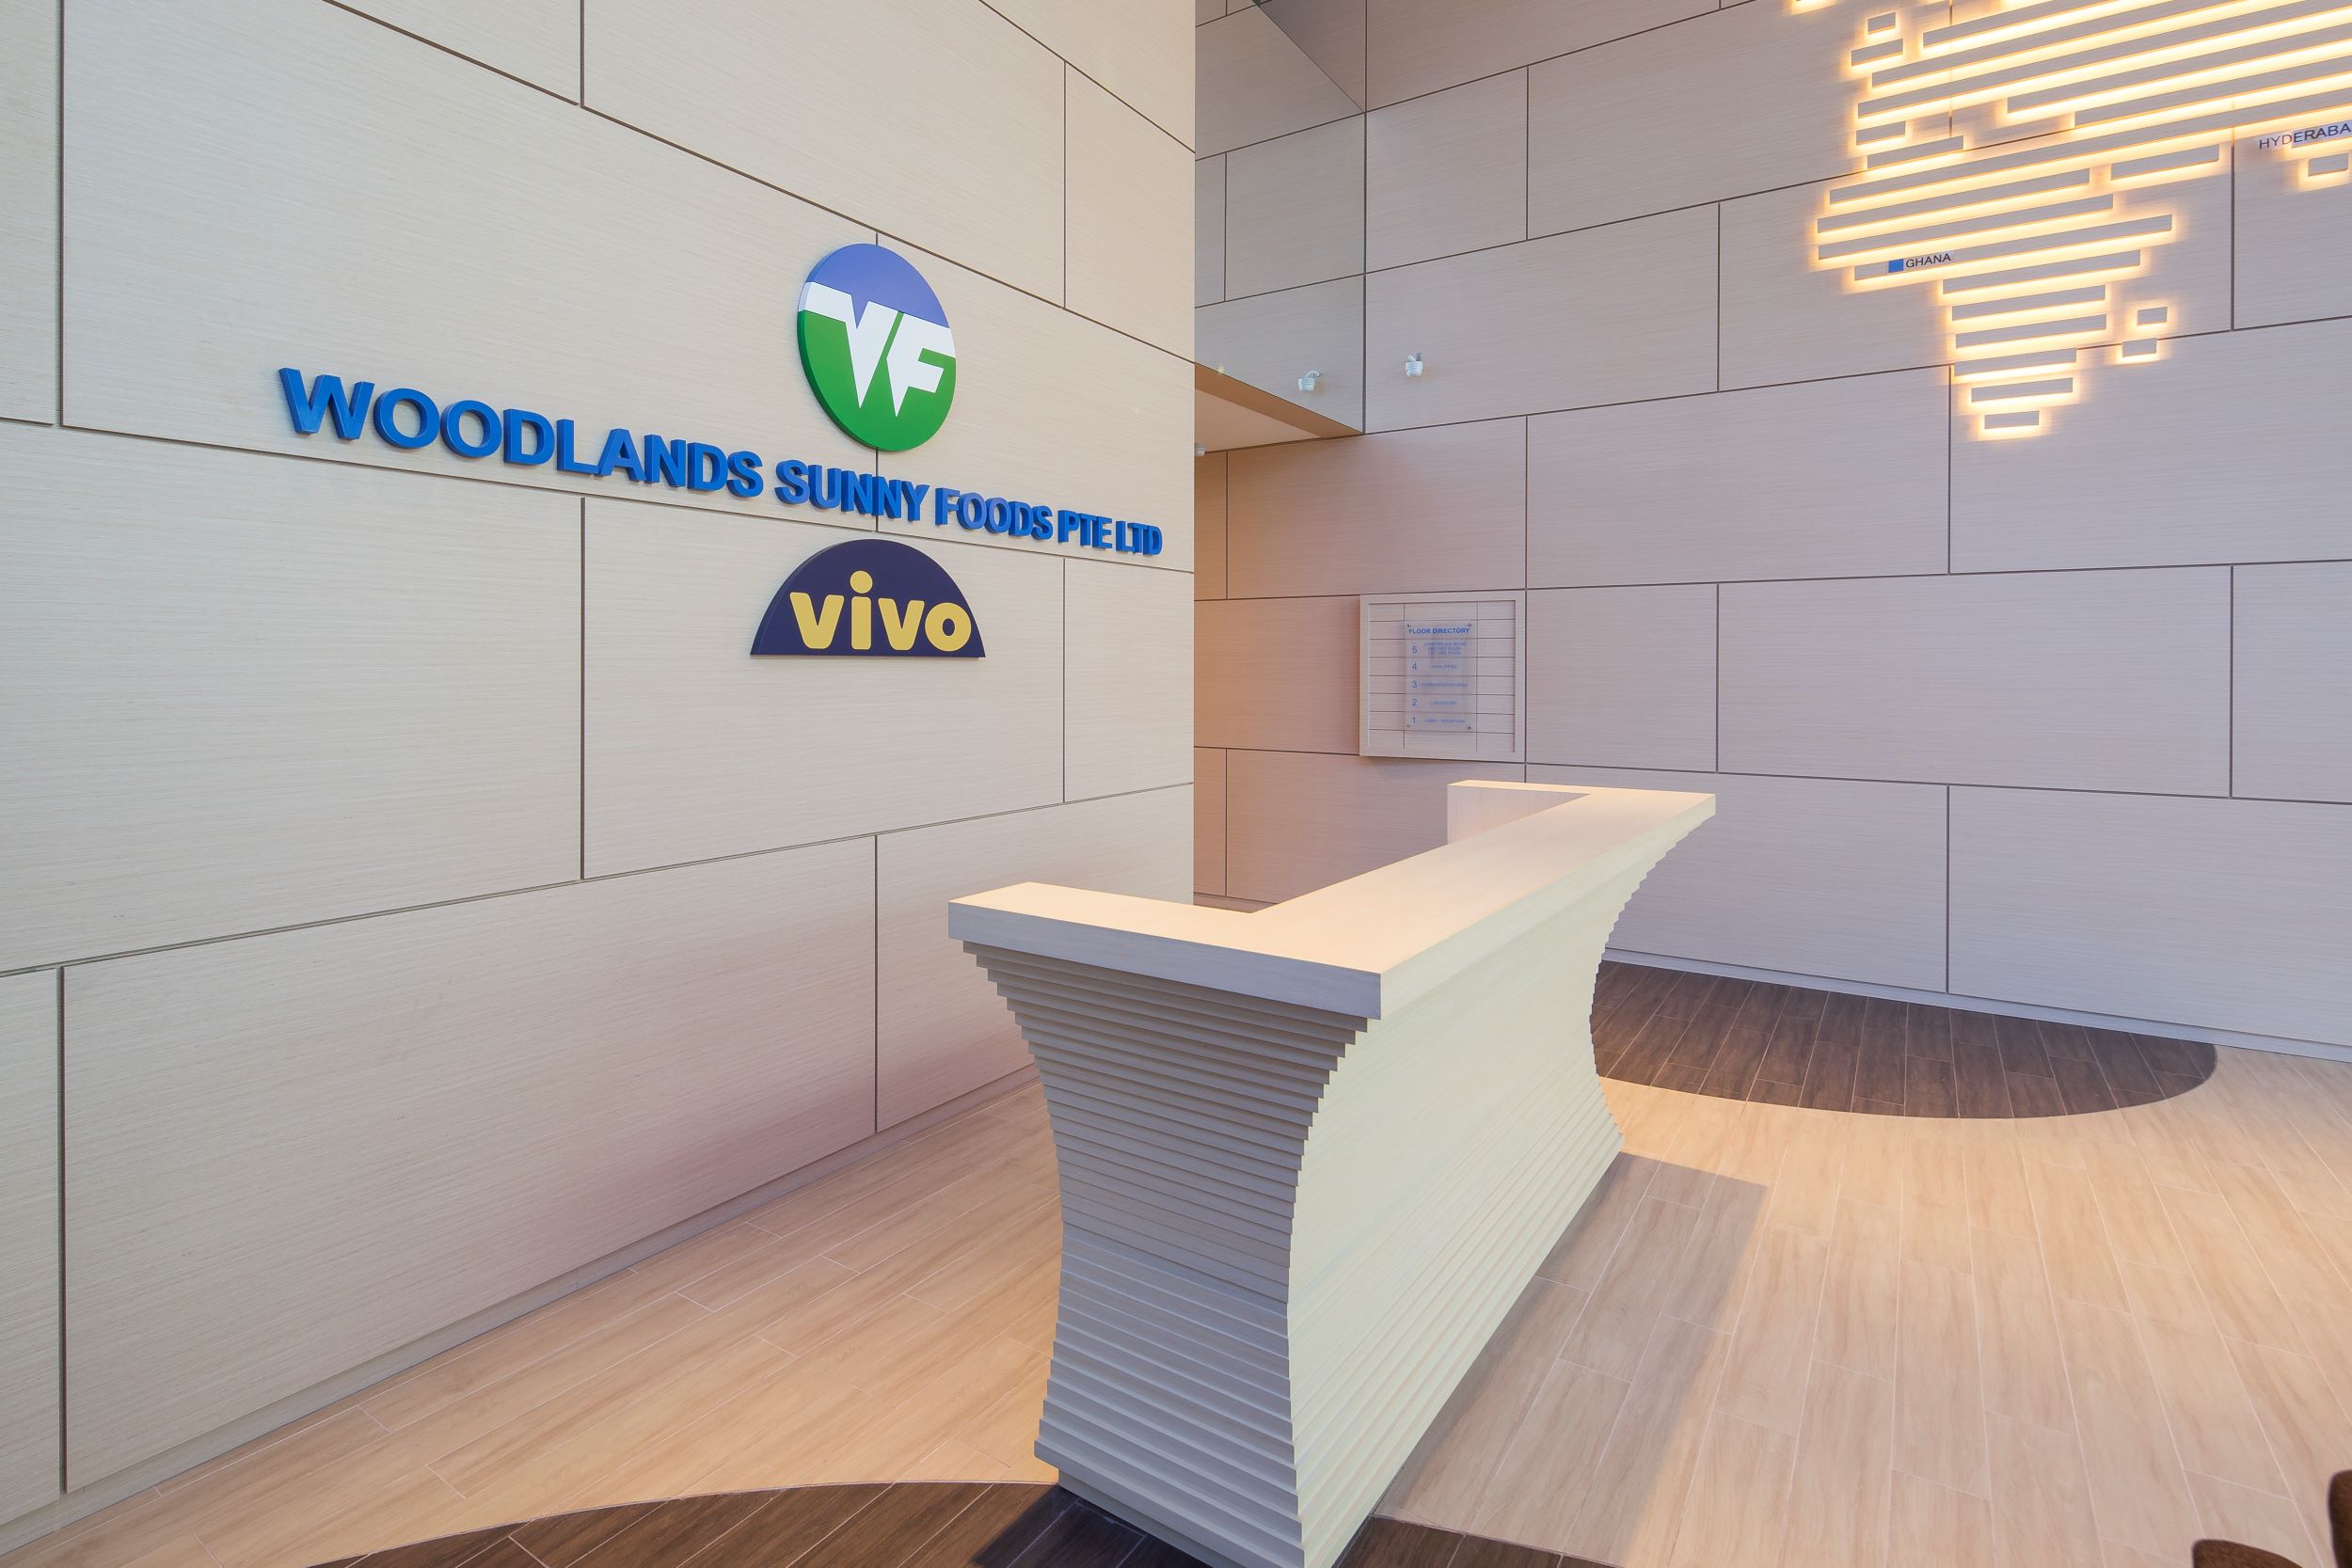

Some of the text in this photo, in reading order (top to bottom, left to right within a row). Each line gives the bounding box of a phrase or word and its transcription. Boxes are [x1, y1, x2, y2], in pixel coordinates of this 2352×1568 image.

[1905, 252, 1951, 268] GHANA
[278, 367, 1163, 556] WOODLANDS SUNNY FOODS PTE LTD
[789, 570, 972, 651] vivo
[1411, 646, 1418, 655] 5
[1411, 680, 1418, 689] 3
[1411, 698, 1418, 706] 2
